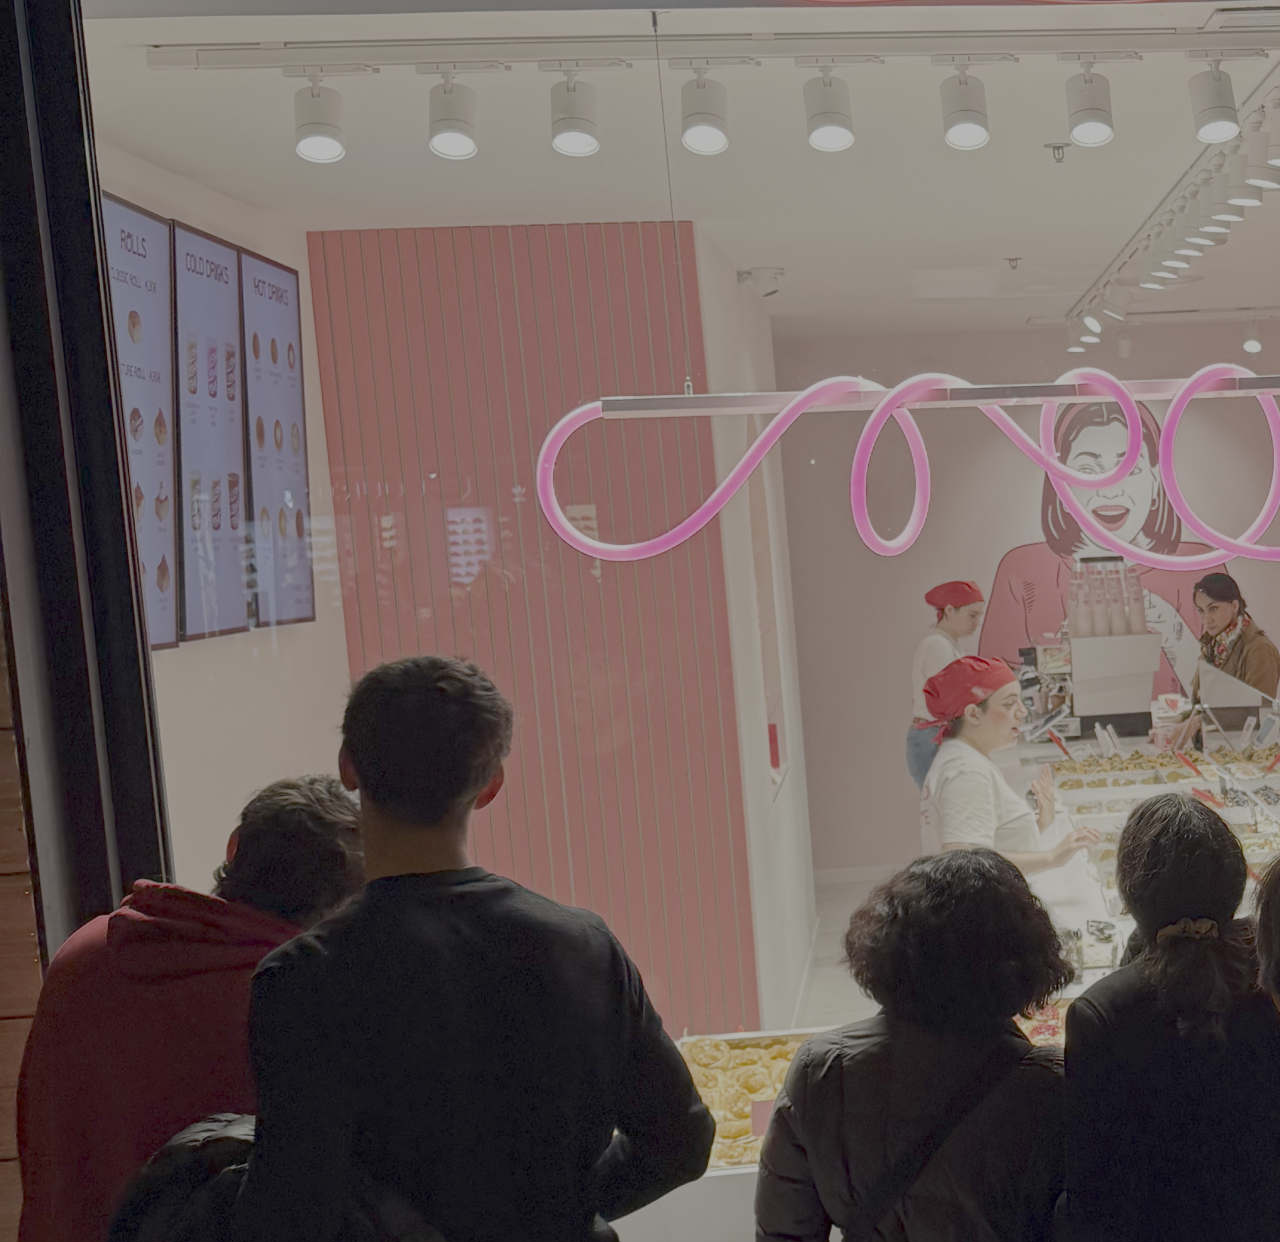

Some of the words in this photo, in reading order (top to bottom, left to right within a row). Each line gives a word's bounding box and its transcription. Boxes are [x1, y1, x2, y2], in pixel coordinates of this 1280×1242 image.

[120, 228, 146, 259] ROLLS
[186, 252, 204, 276] COLD
[206, 259, 229, 285] DRINKS
[253, 277, 266, 298] HOT
[268, 283, 289, 306] DRINKS
